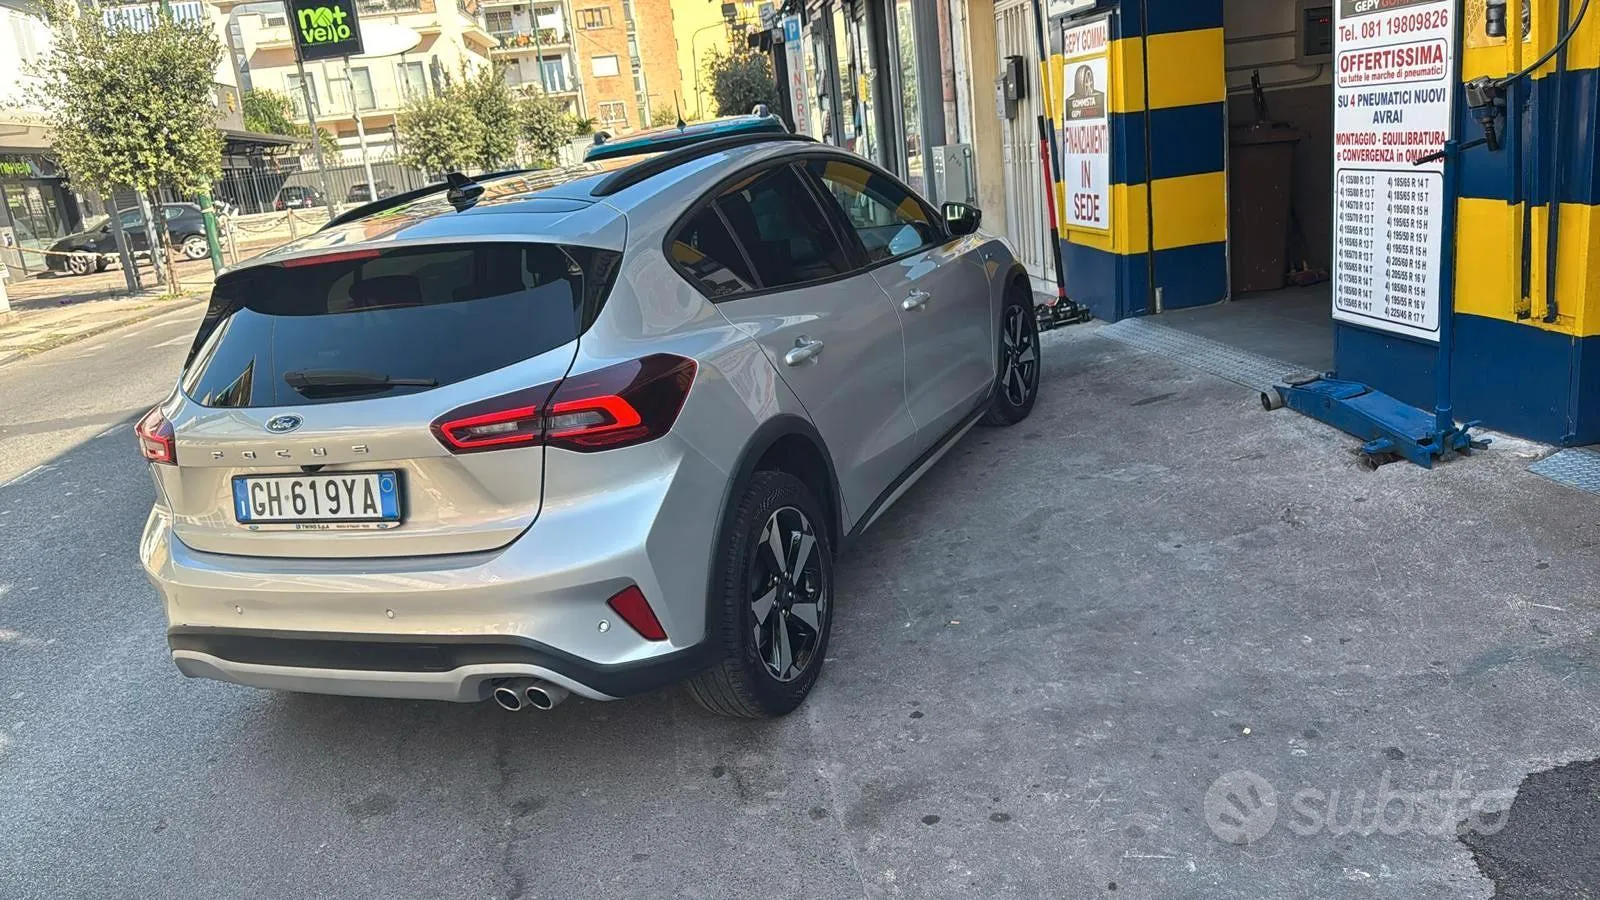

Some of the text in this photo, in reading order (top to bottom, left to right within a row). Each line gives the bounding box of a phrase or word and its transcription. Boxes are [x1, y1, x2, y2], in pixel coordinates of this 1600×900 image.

[1355, 0, 1380, 12] GEPY
[302, 25, 350, 43] vello
[1339, 9, 1448, 42] Tel. 081 19809826
[1065, 26, 1106, 54] GEPY GOMMA
[1340, 44, 1443, 73] OFFERTISSIMA
[1348, 73, 1362, 83] tutte
[1364, 72, 1370, 80] le
[1372, 69, 1394, 80] marche
[1396, 68, 1403, 78] di
[1404, 65, 1443, 80] pneumatici
[1338, 88, 1445, 108] SU 4 PNEUMATICI NUOVI
[1372, 110, 1403, 124] AVRAI
[1336, 132, 1376, 146] MONTAGGIO
[1383, 131, 1445, 146] EQUILIBRATURA
[1337, 153, 1341, 161] e
[1343, 149, 1394, 162] CONVERGENZA
[1396, 150, 1403, 162] in
[1081, 160, 1091, 188] IN
[1074, 194, 1100, 222] SEDE
[211, 444, 369, 459] FOCUS
